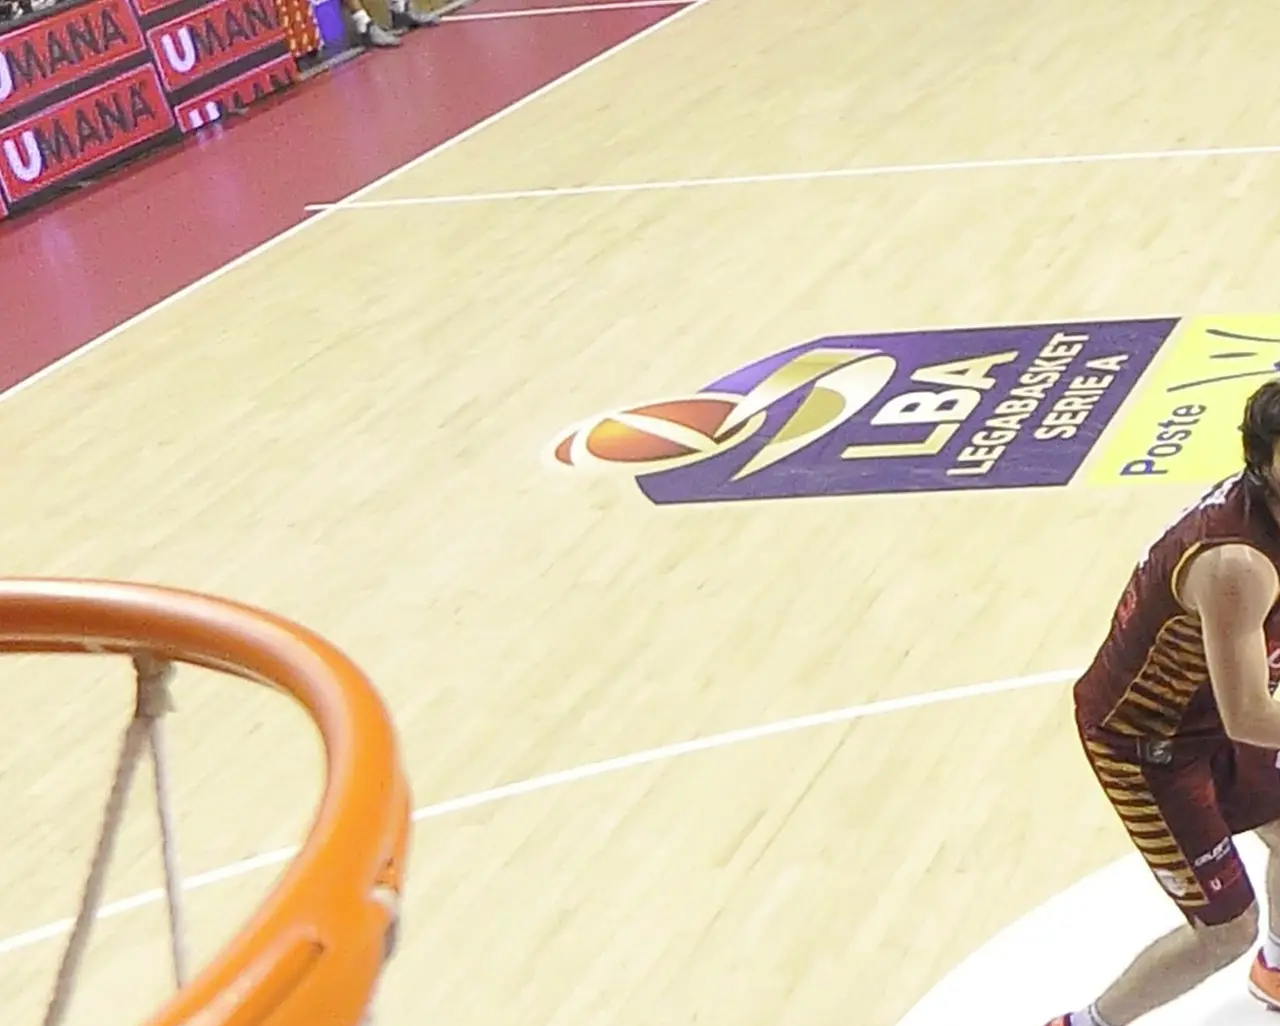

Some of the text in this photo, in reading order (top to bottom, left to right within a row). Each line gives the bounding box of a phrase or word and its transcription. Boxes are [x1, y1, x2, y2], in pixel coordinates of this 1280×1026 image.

[161, 0, 281, 73] UMAN
[3, 80, 155, 183] UMANA
[840, 350, 1020, 461] LBA
[946, 331, 1091, 477] LEGABASKET
[1033, 353, 1129, 440] SERIE A
[1119, 403, 1207, 477] Poste
